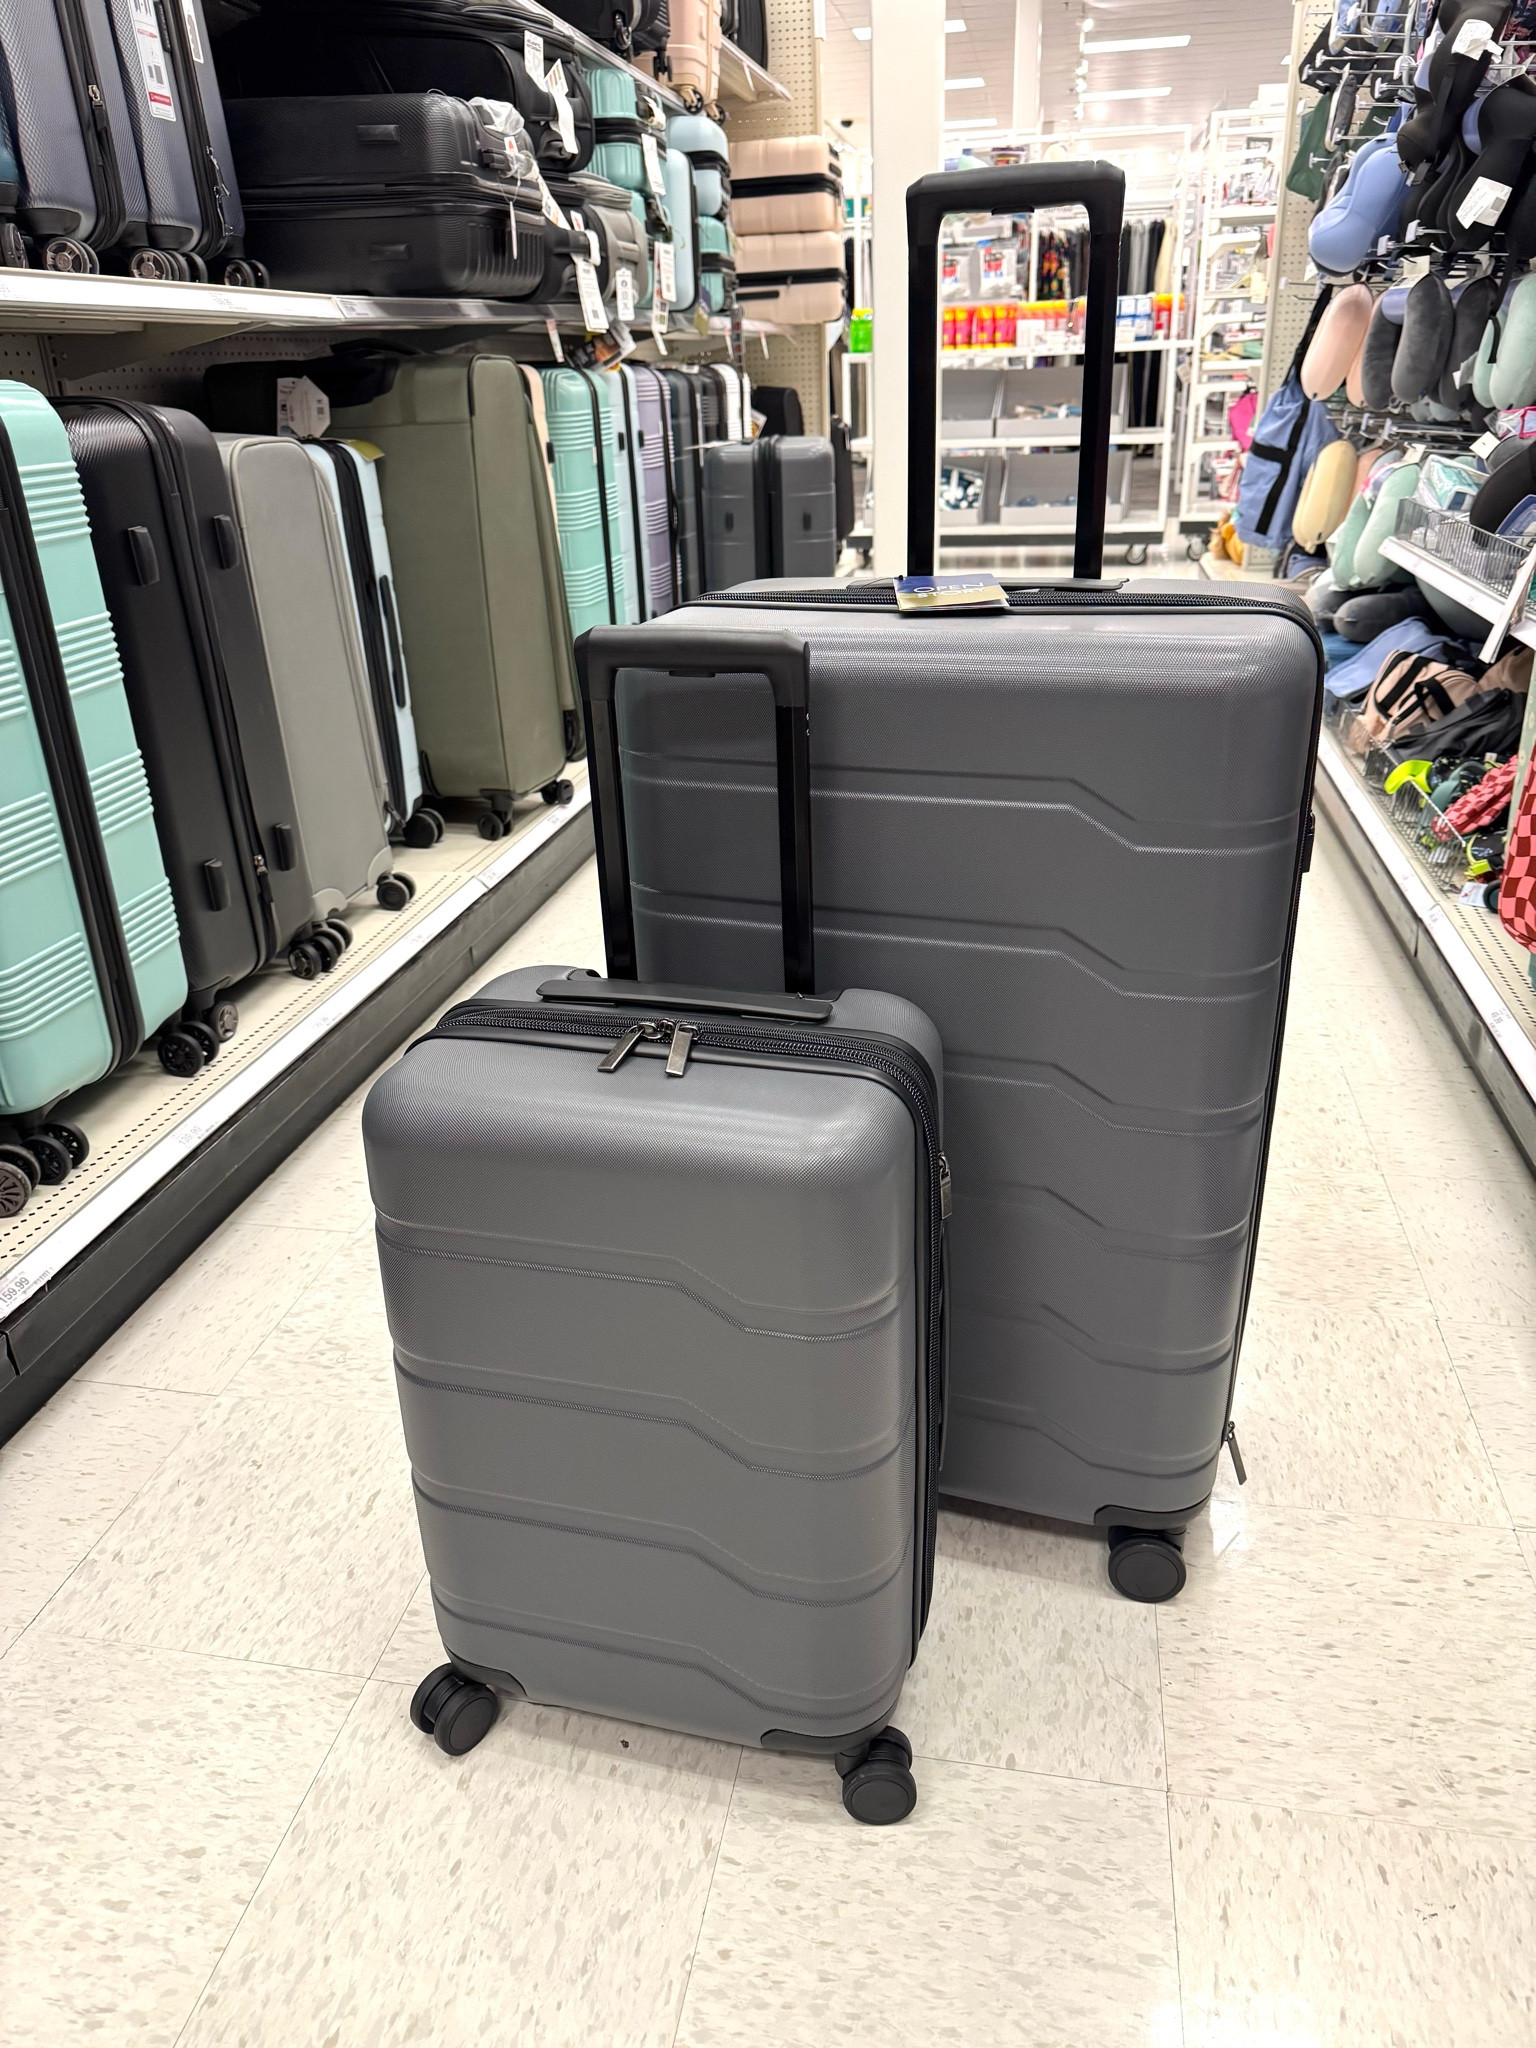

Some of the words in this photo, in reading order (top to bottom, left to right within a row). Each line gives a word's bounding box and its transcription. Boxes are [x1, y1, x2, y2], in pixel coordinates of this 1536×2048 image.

[913, 582, 984, 593] OPEN
[916, 587, 985, 598] STORY
[0, 1276, 30, 1303] 159.99
